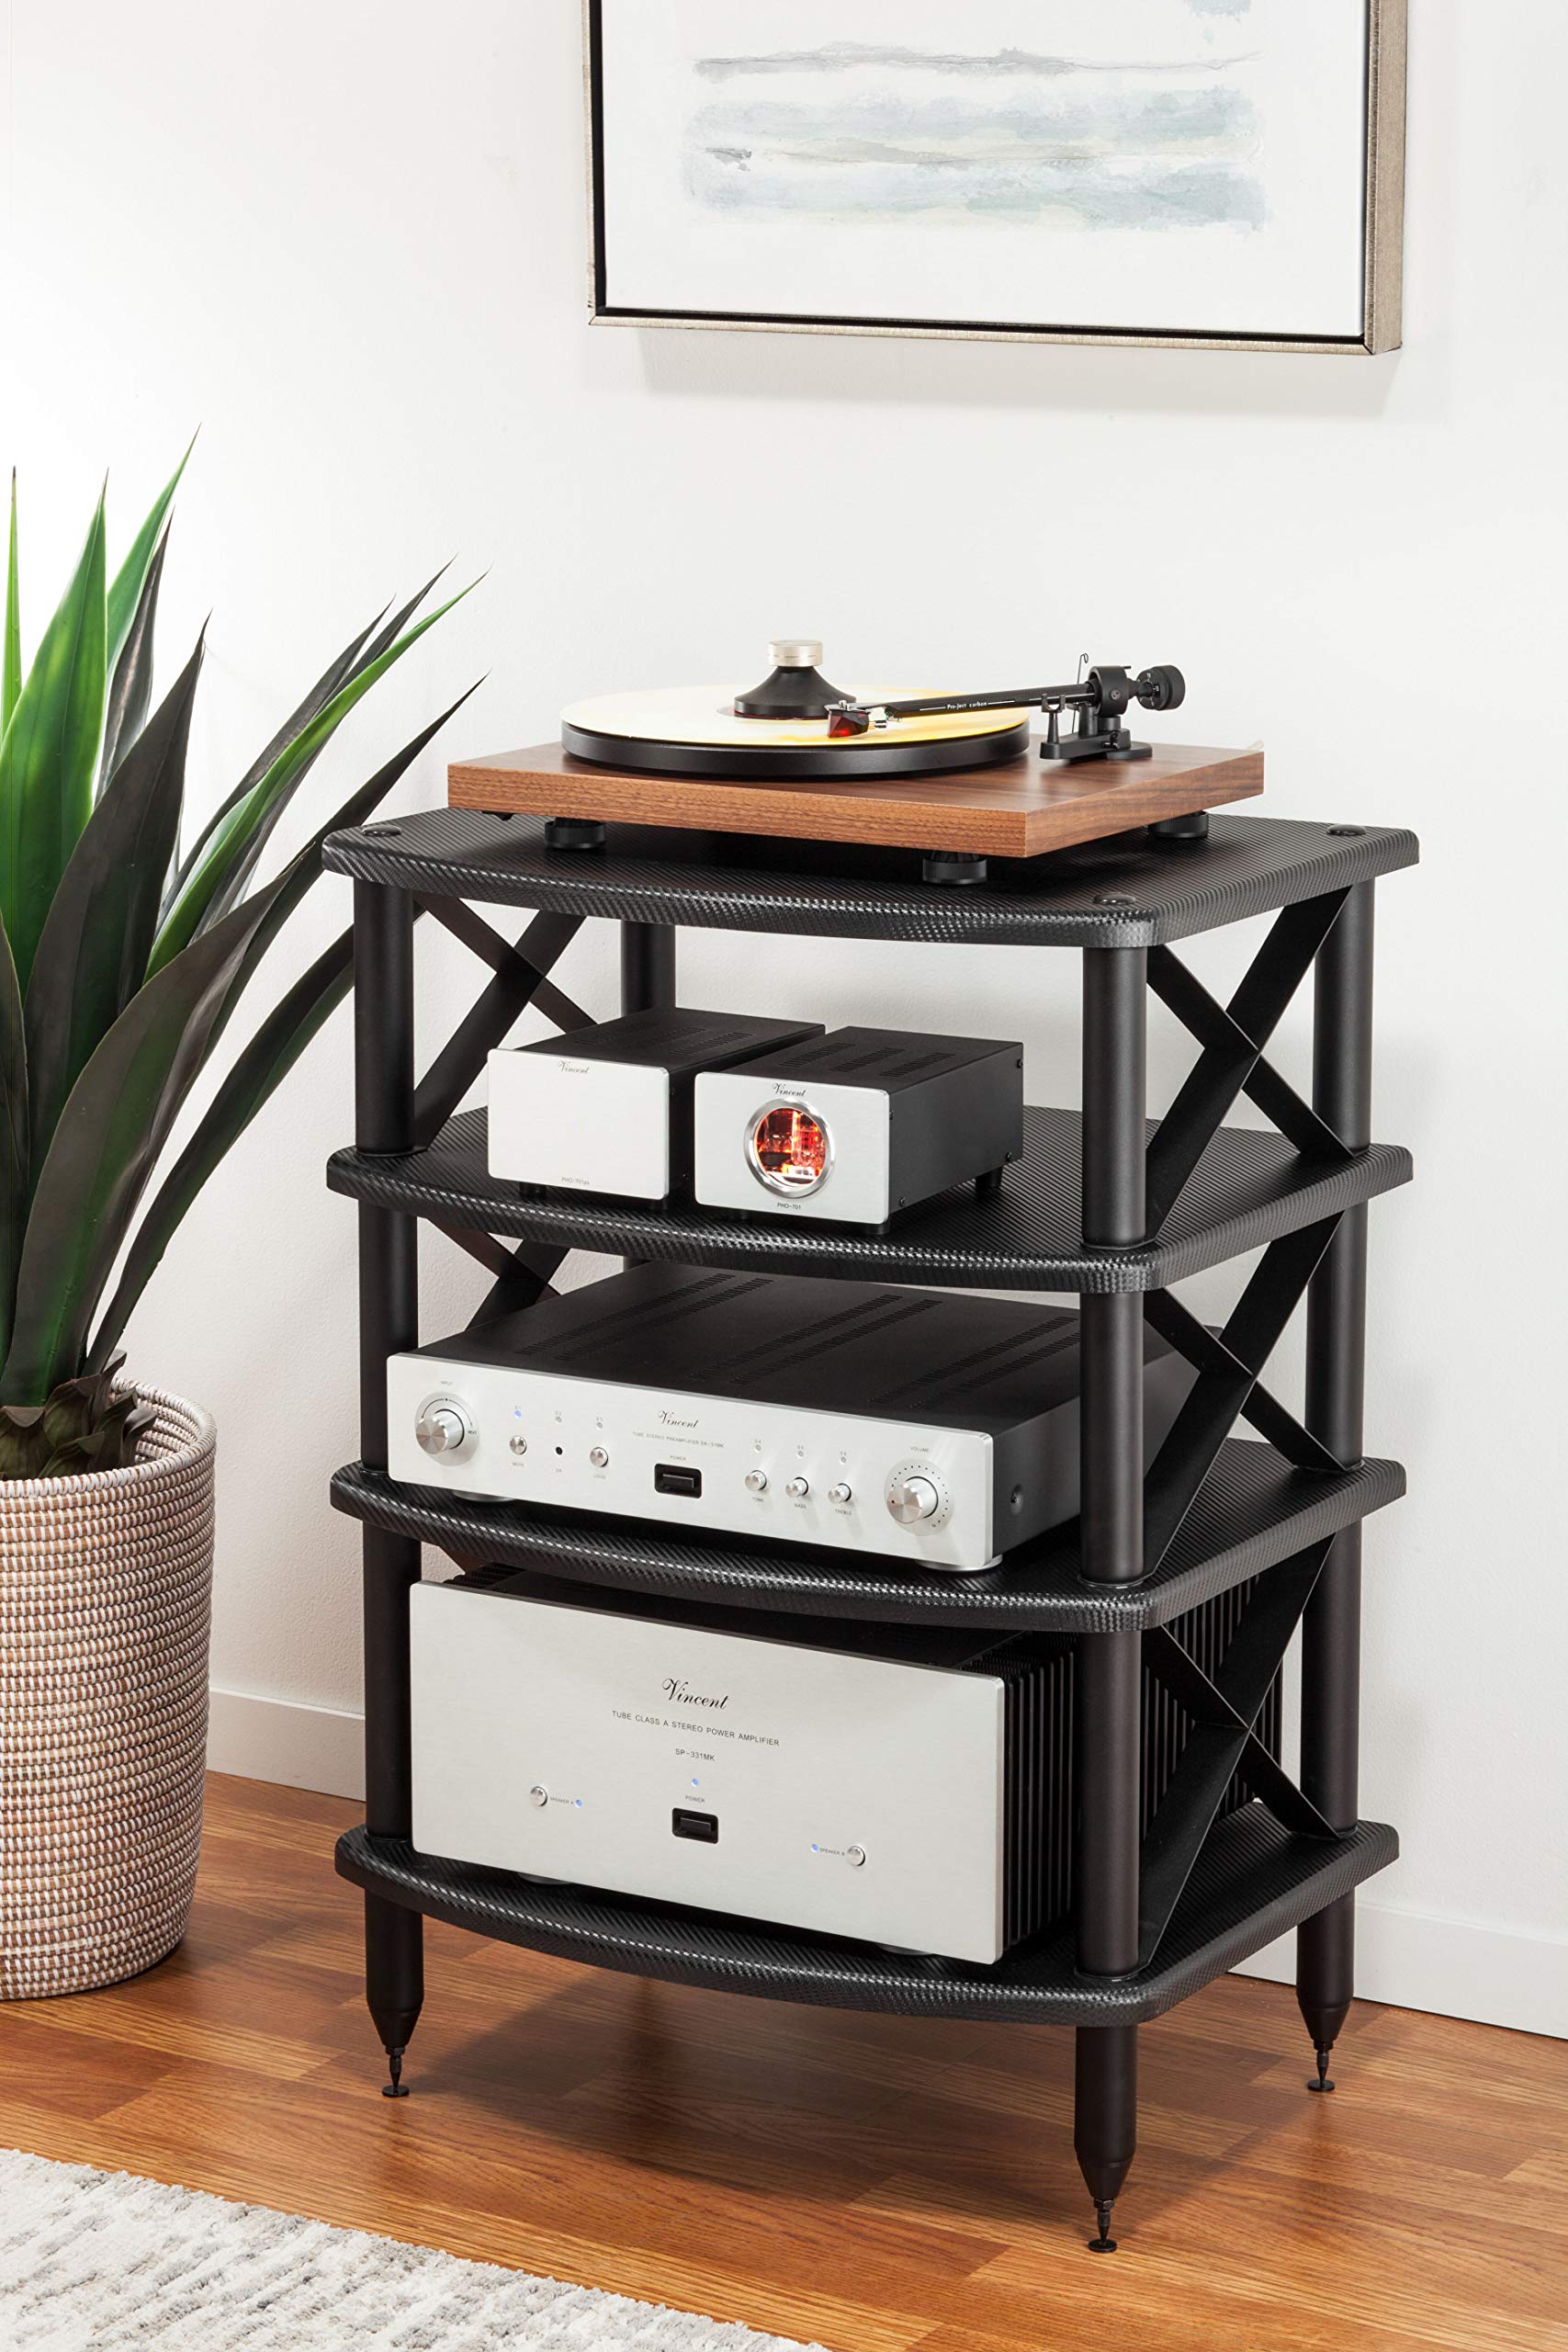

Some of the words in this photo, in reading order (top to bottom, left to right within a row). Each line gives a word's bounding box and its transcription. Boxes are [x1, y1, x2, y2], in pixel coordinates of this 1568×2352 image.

[558, 1059, 590, 1074] Vincent
[772, 1082, 807, 1097] Vincent
[658, 1409, 699, 1429] Vincent
[661, 1678, 729, 1711] Vincent
[612, 1710, 633, 1721] TUBE
[635, 1714, 660, 1725] CLASS
[671, 1721, 704, 1734] STEREO
[705, 1726, 736, 1739] POWER
[738, 1733, 781, 1747] AMPLIFIER
[675, 1747, 716, 1762] SP-331MK
[684, 1794, 705, 1804] POWER
